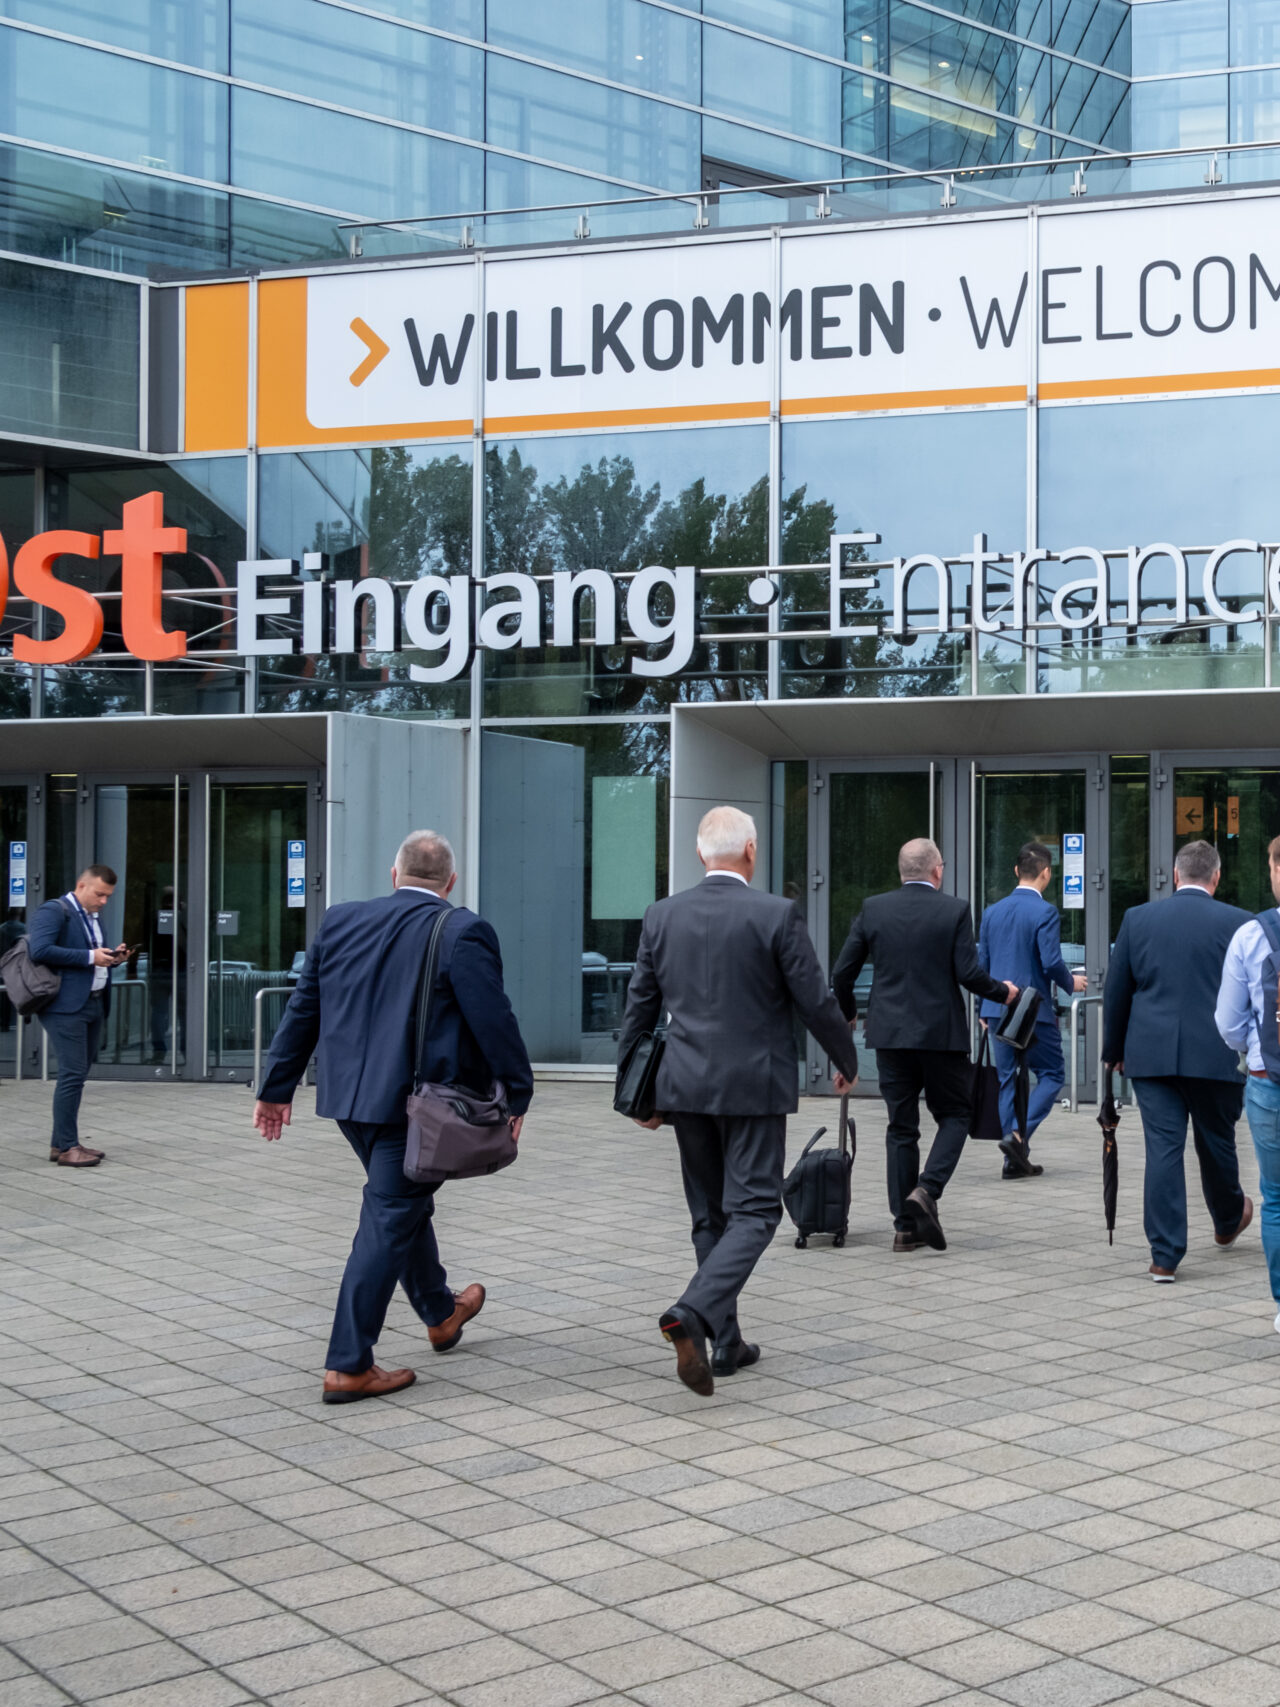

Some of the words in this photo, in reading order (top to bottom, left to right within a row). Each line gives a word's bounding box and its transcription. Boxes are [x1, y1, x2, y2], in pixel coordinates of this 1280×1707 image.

[402, 279, 906, 388] WILLKOMMEN
[0, 490, 188, 664] st
[236, 551, 697, 683] Eingang
